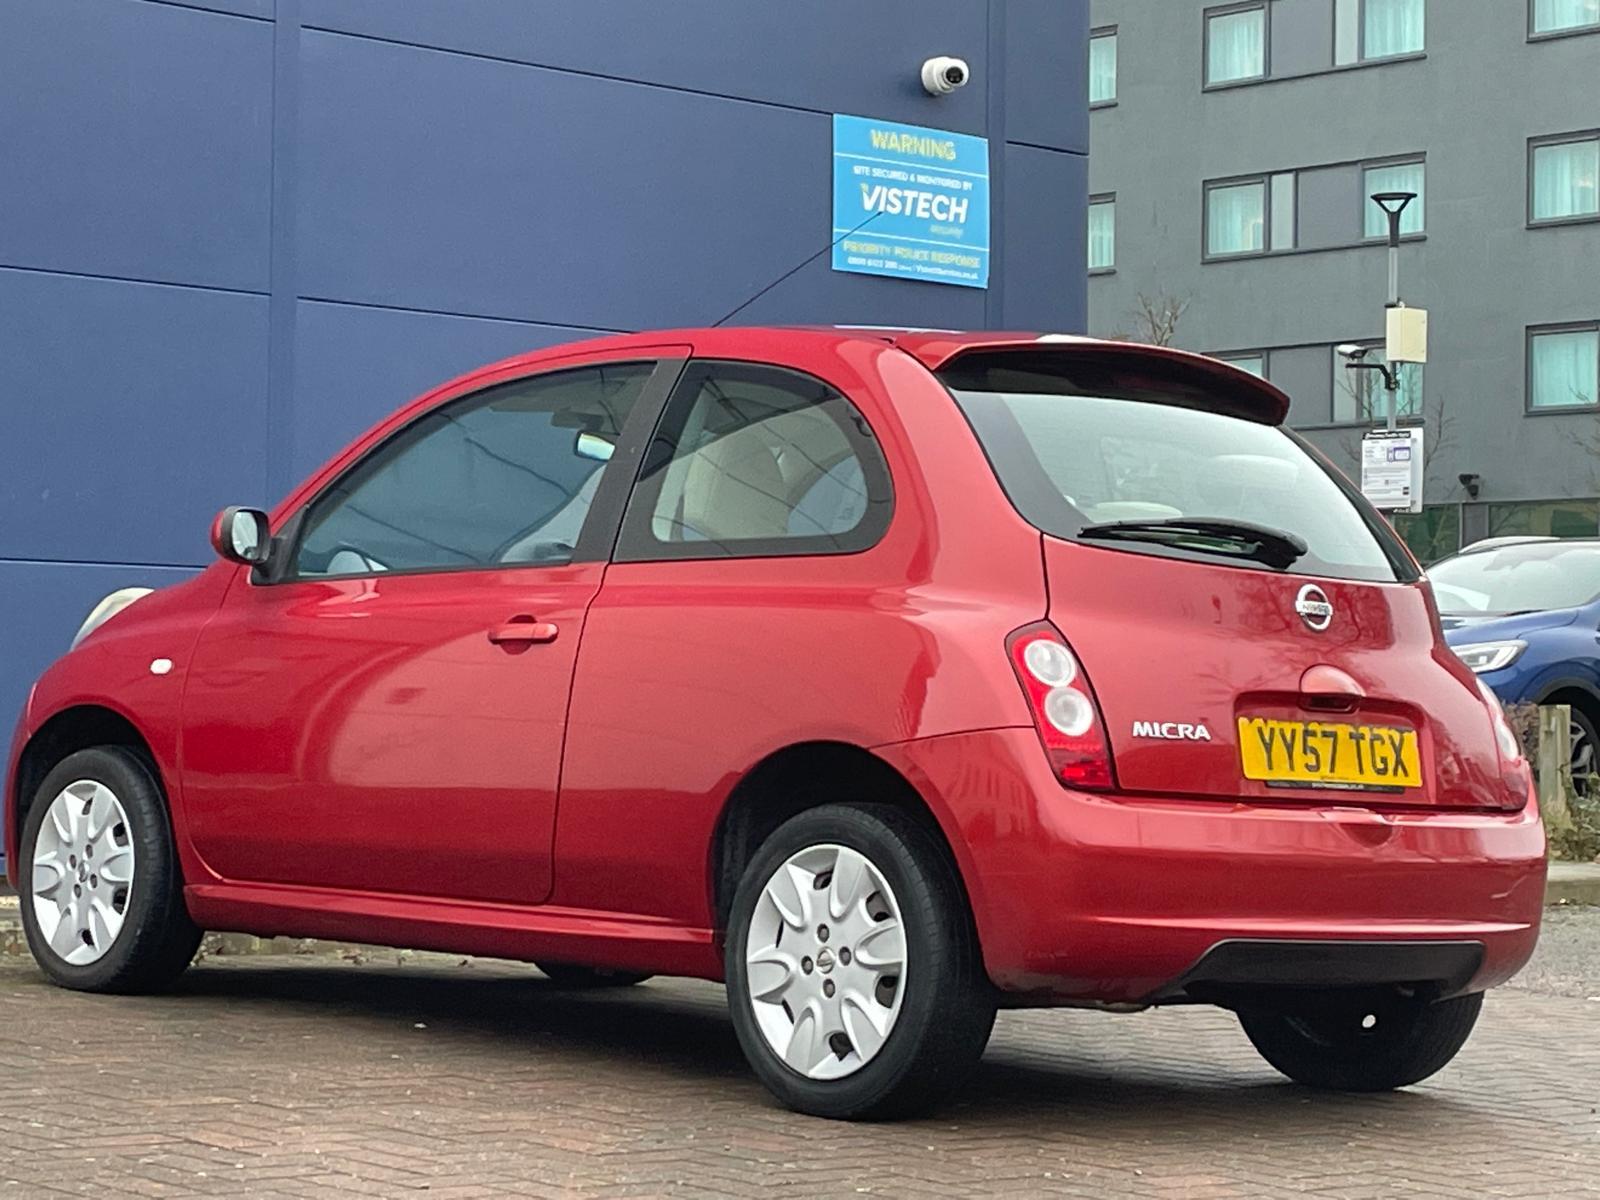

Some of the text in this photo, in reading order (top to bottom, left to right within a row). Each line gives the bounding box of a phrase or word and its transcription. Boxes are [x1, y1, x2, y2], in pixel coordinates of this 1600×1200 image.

[870, 129, 957, 160] WARNING
[853, 165, 871, 177] SITE
[872, 167, 909, 182] SECURED
[963, 181, 973, 191] BY
[861, 183, 969, 224] VISTECH
[1132, 720, 1212, 741] MICRA
[1257, 726, 1409, 778] YY57 TGX
